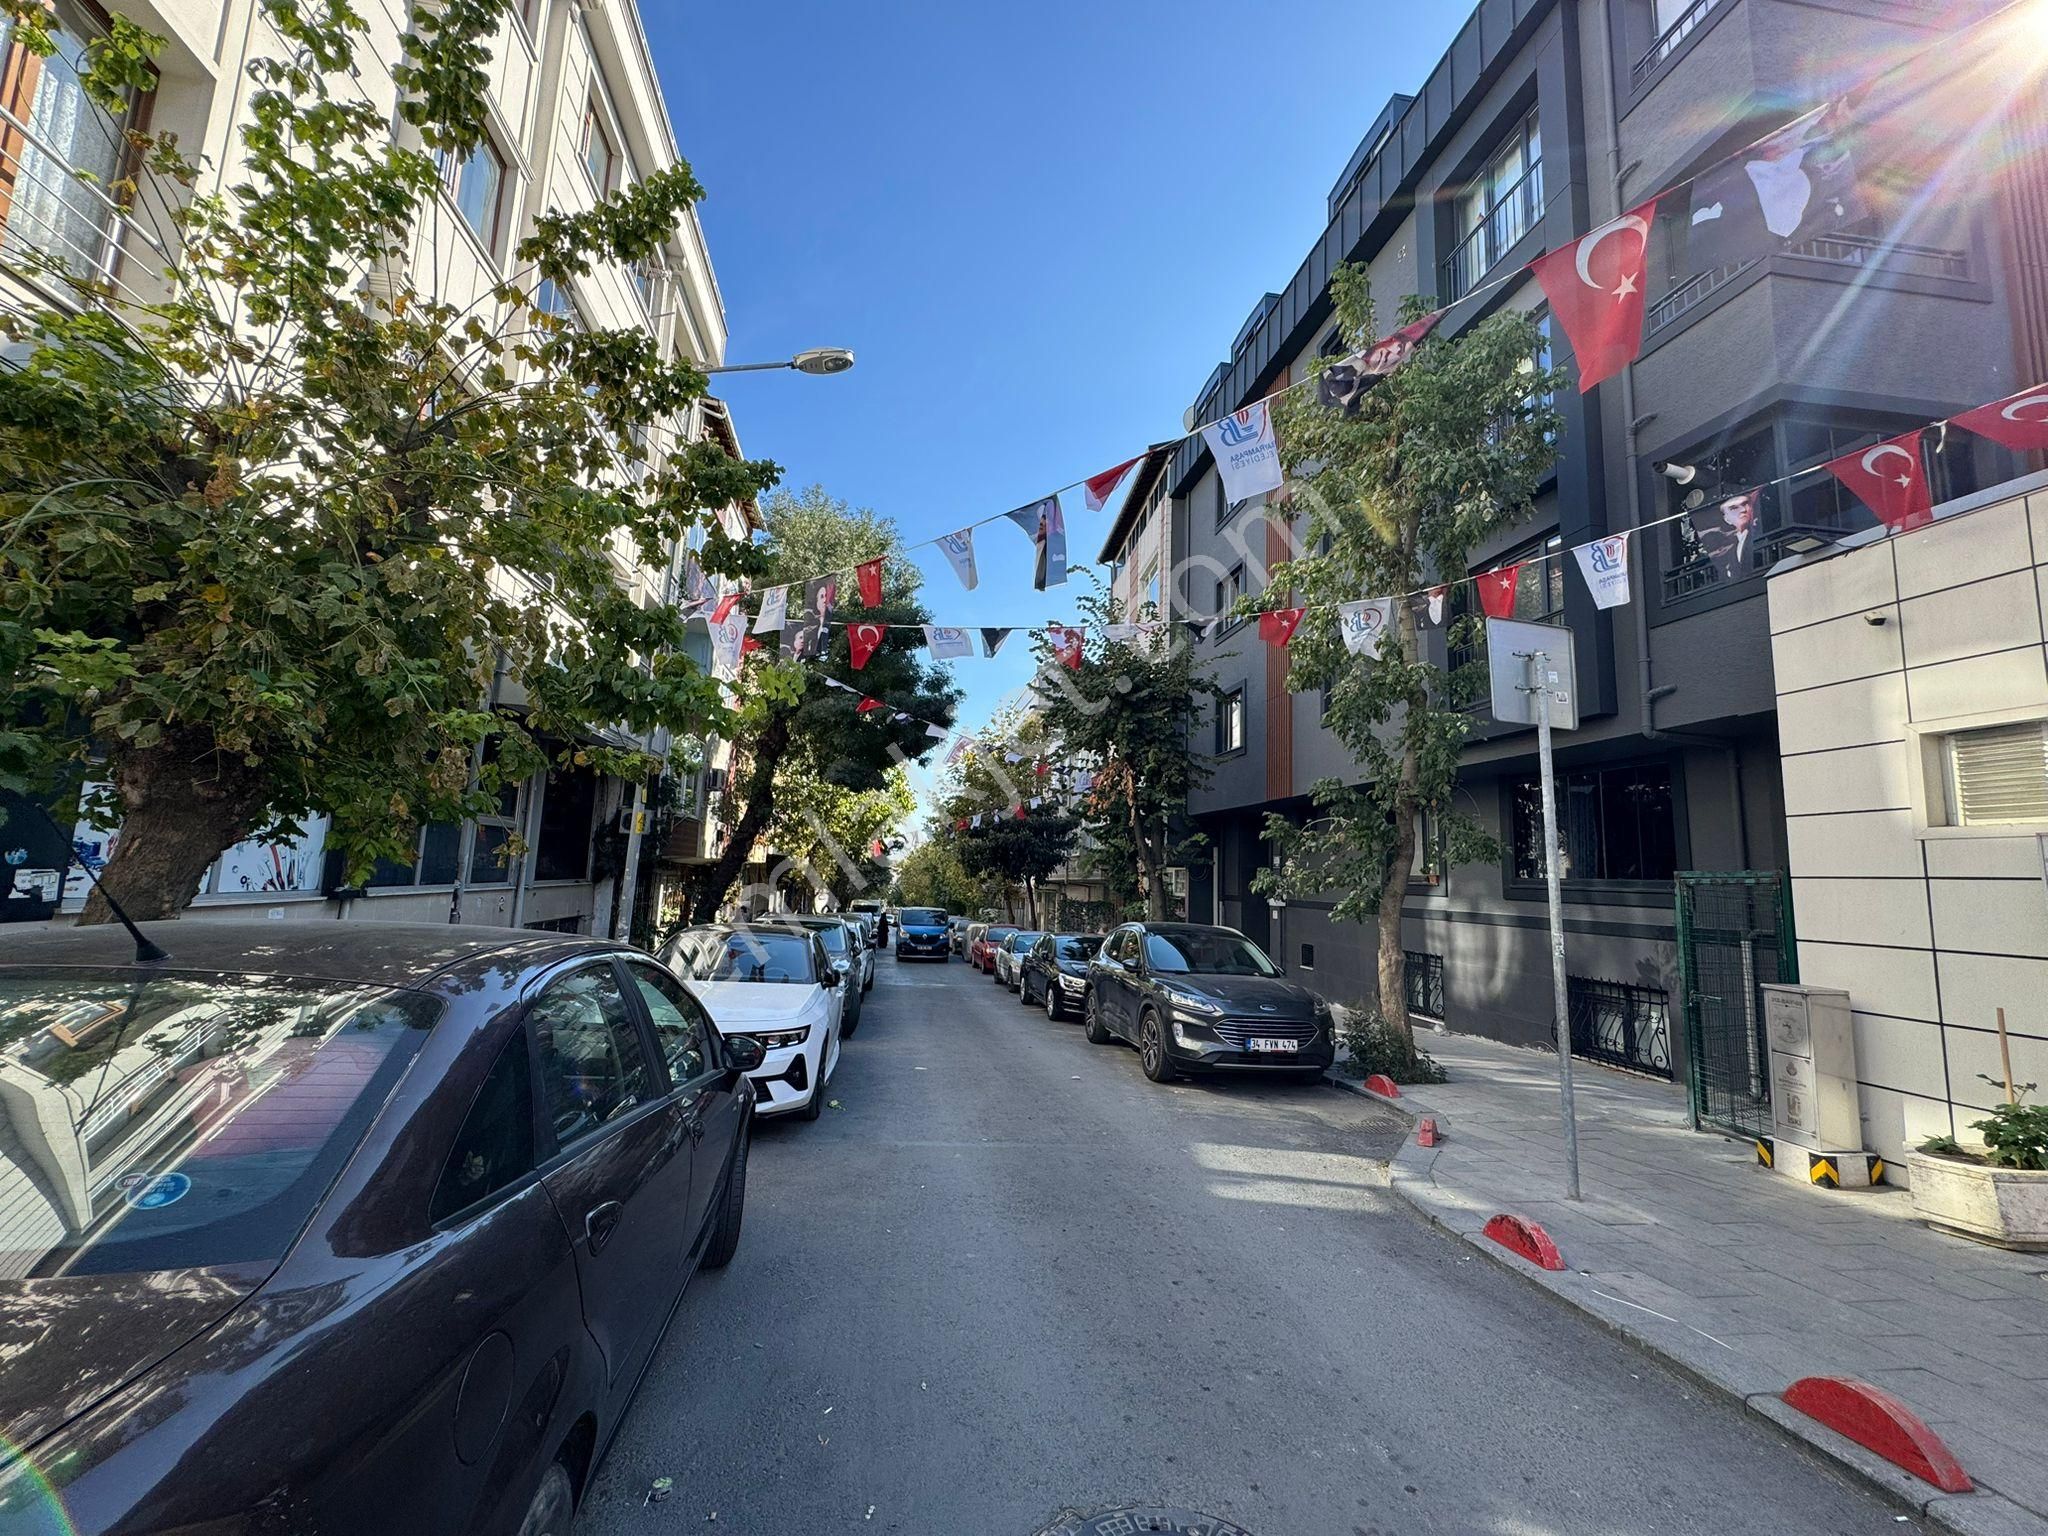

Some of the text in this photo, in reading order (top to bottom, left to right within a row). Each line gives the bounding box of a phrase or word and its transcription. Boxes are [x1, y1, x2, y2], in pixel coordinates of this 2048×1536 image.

[1251, 1039, 1296, 1050] 34 FVN 474
